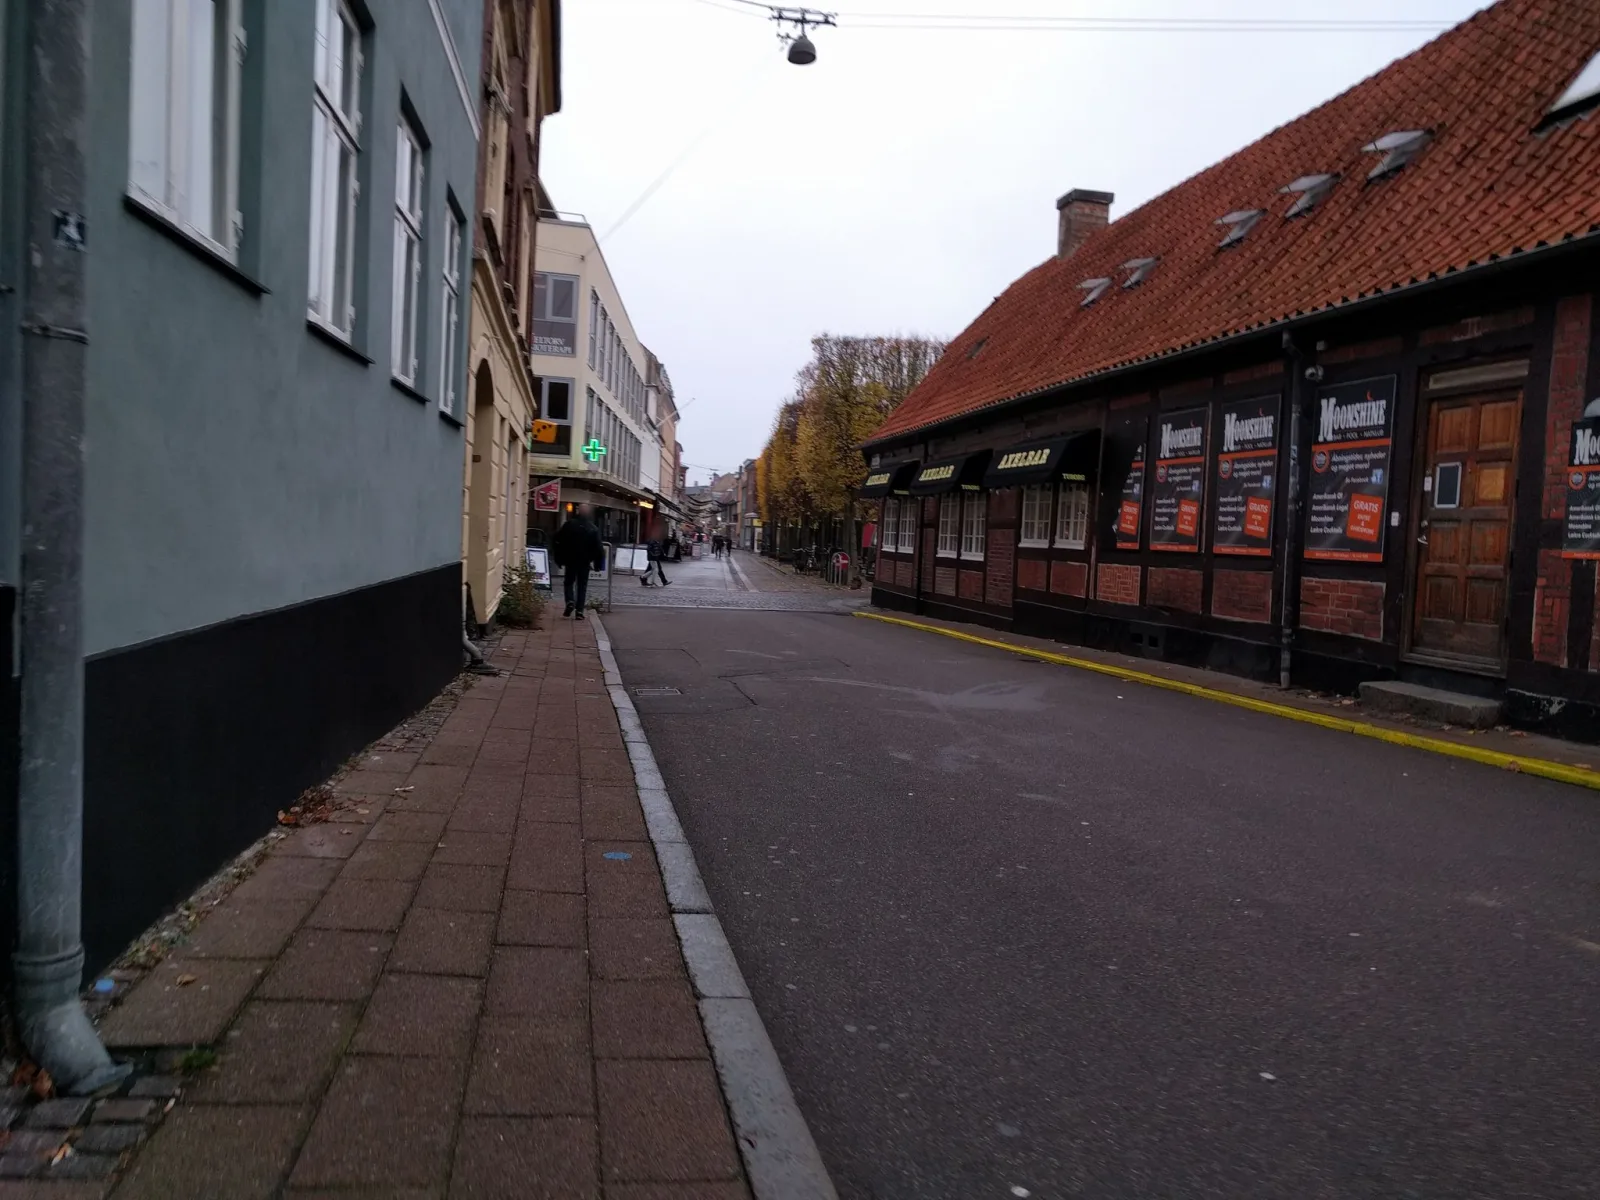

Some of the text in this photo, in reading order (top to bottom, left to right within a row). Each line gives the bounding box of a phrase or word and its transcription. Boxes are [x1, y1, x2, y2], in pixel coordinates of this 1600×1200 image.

[1318, 397, 1386, 442] MOONSHINE
[997, 448, 1051, 469] AXELBAR
[1354, 500, 1379, 513] GRATIS
